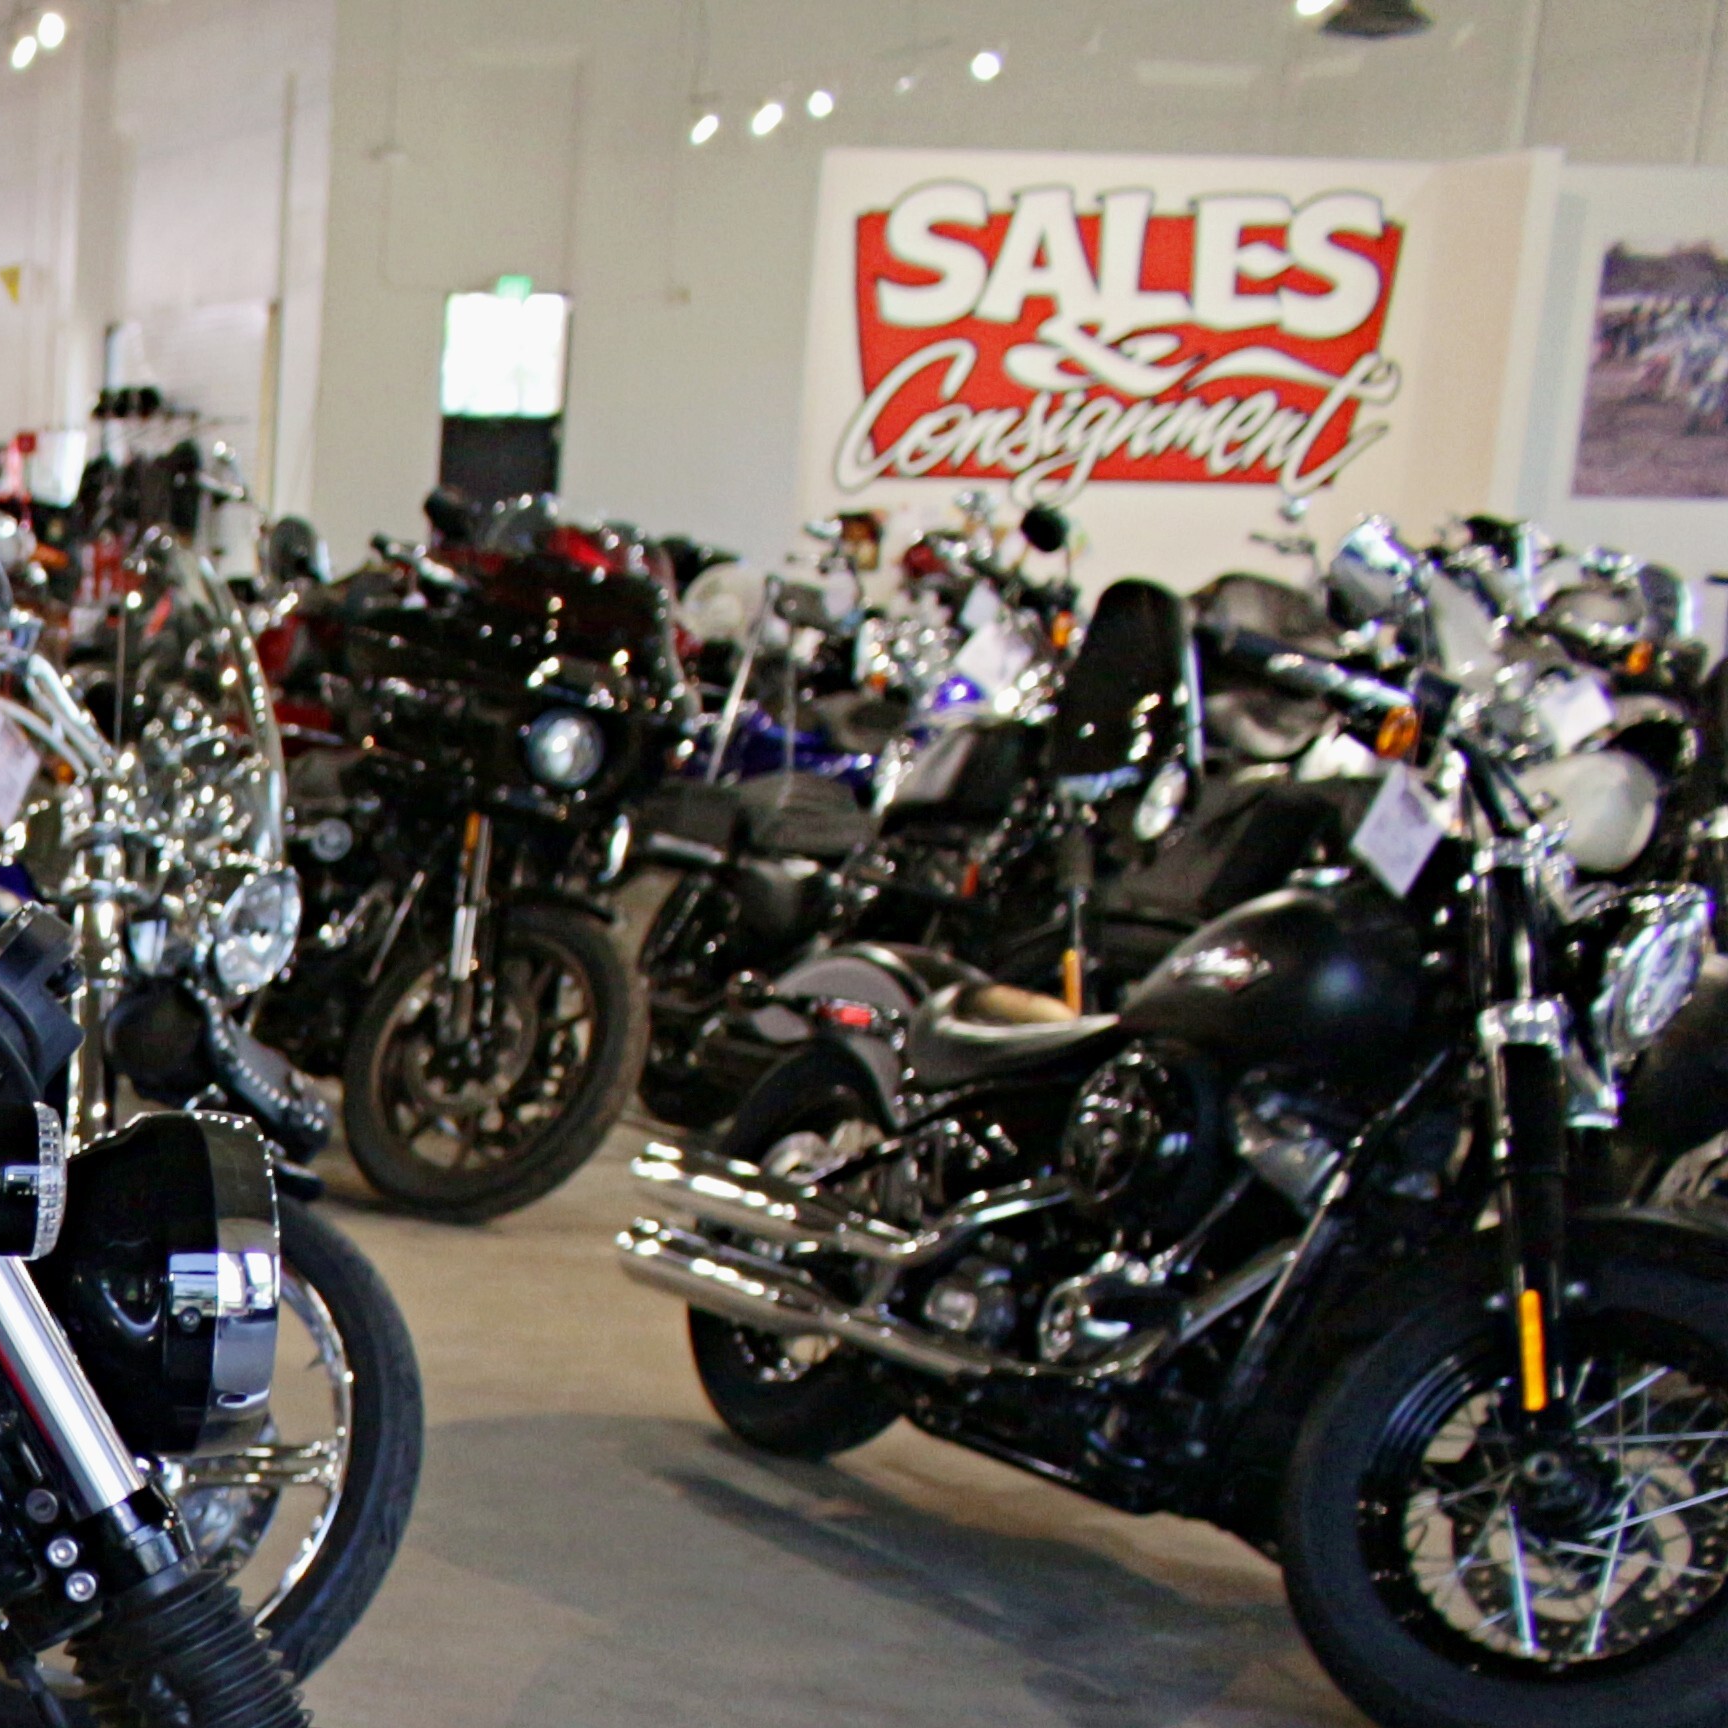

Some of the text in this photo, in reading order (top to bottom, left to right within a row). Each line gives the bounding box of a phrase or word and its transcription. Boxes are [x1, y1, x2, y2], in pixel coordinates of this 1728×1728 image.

[876, 179, 1384, 339] SALES
[833, 338, 1402, 508] Consignment
[1002, 312, 1208, 398] &
